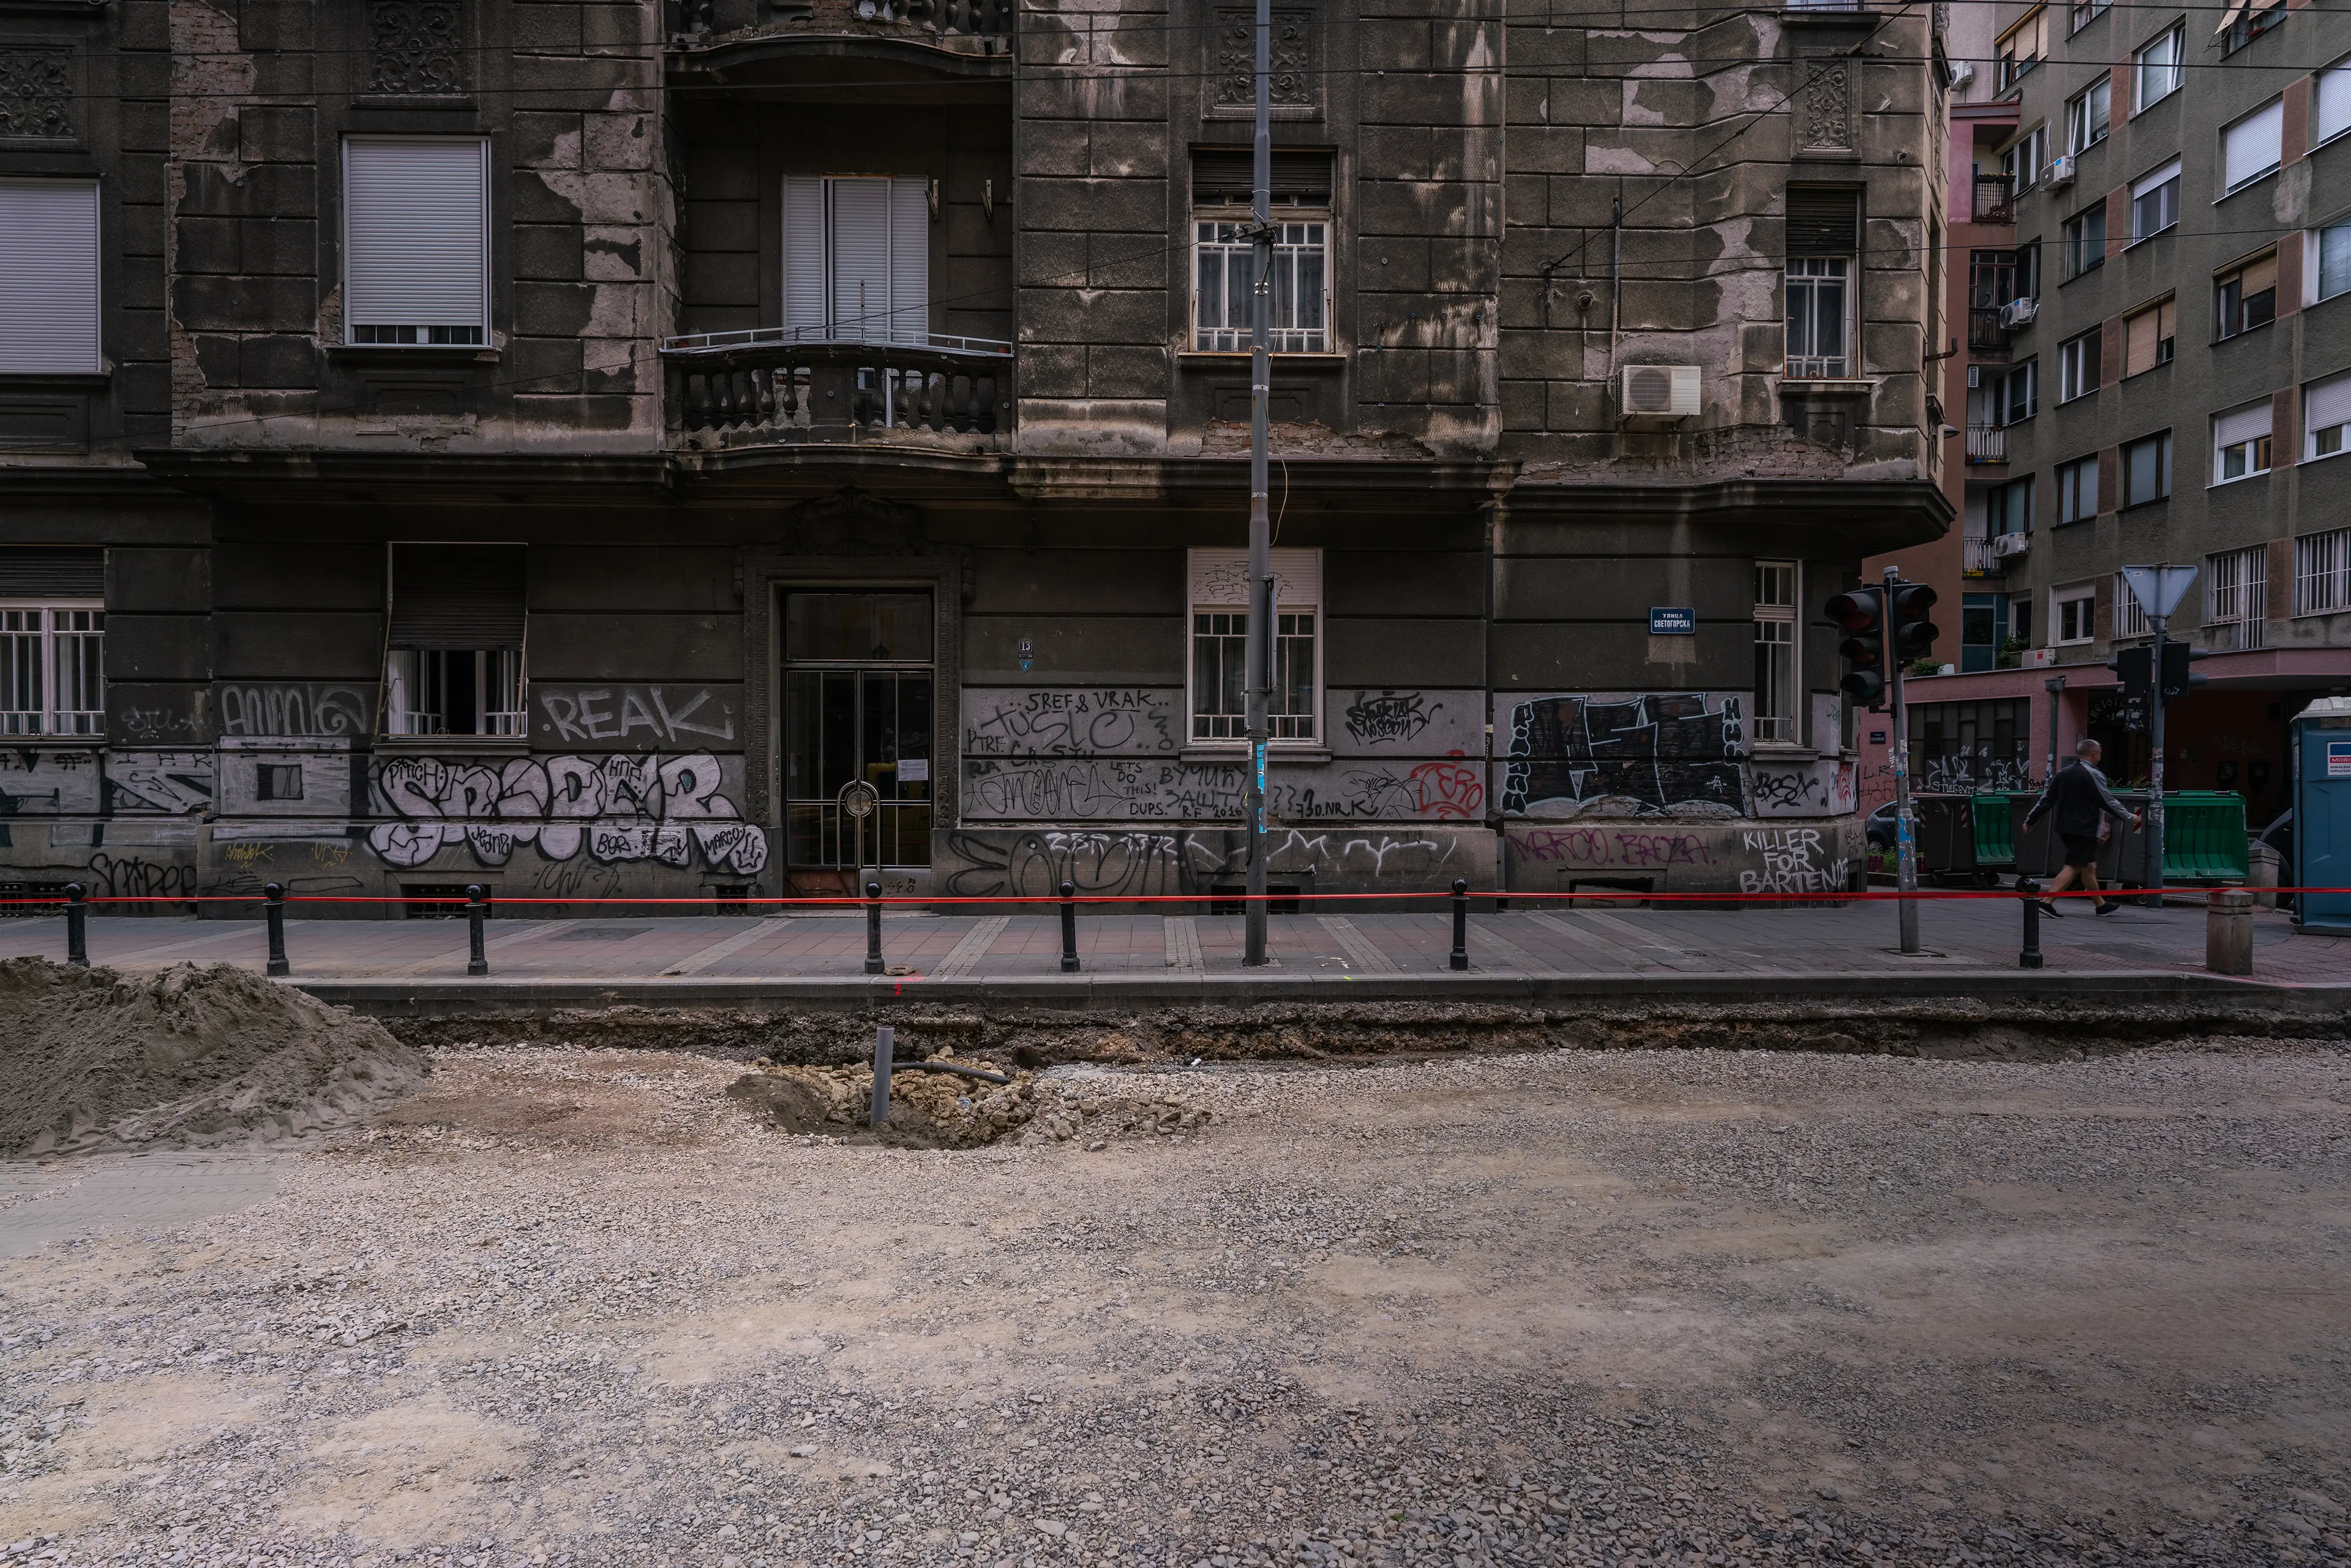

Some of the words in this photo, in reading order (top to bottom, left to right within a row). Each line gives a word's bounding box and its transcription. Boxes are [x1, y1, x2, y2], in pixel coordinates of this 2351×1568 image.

[1021, 641, 1031, 651] 13
[1117, 772, 1136, 783] DO
[1743, 828, 1825, 856] KILLER
[1763, 849, 1817, 872] FOR
